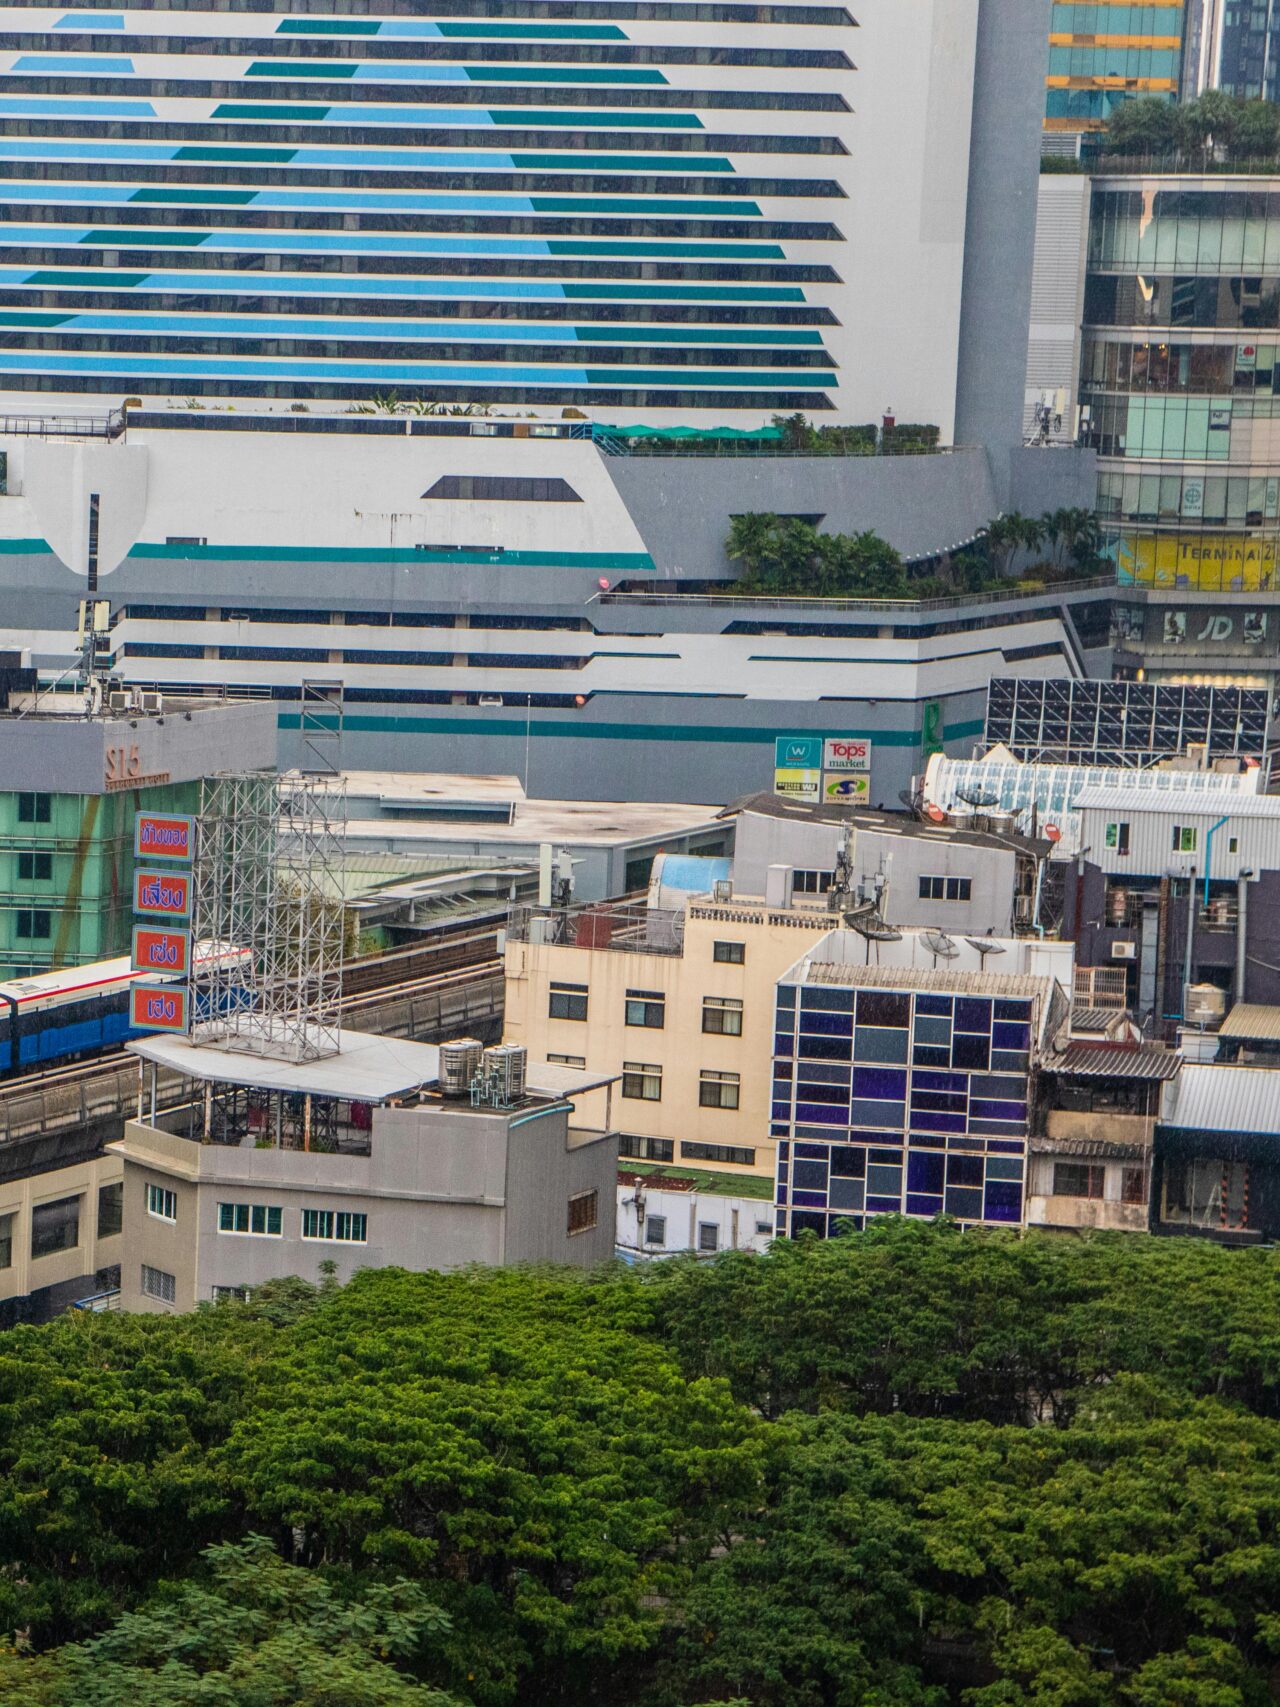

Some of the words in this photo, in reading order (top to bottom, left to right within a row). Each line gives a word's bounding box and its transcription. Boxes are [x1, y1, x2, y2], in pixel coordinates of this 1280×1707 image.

[1197, 615, 1233, 641] JD
[105, 745, 140, 780] S15
[791, 746, 806, 756] W
[829, 742, 866, 761] Tops
[829, 758, 866, 768] market
[140, 821, 187, 846] ห้างทอง
[150, 936, 177, 964] เซ่ง
[147, 995, 175, 1020] เฮง
